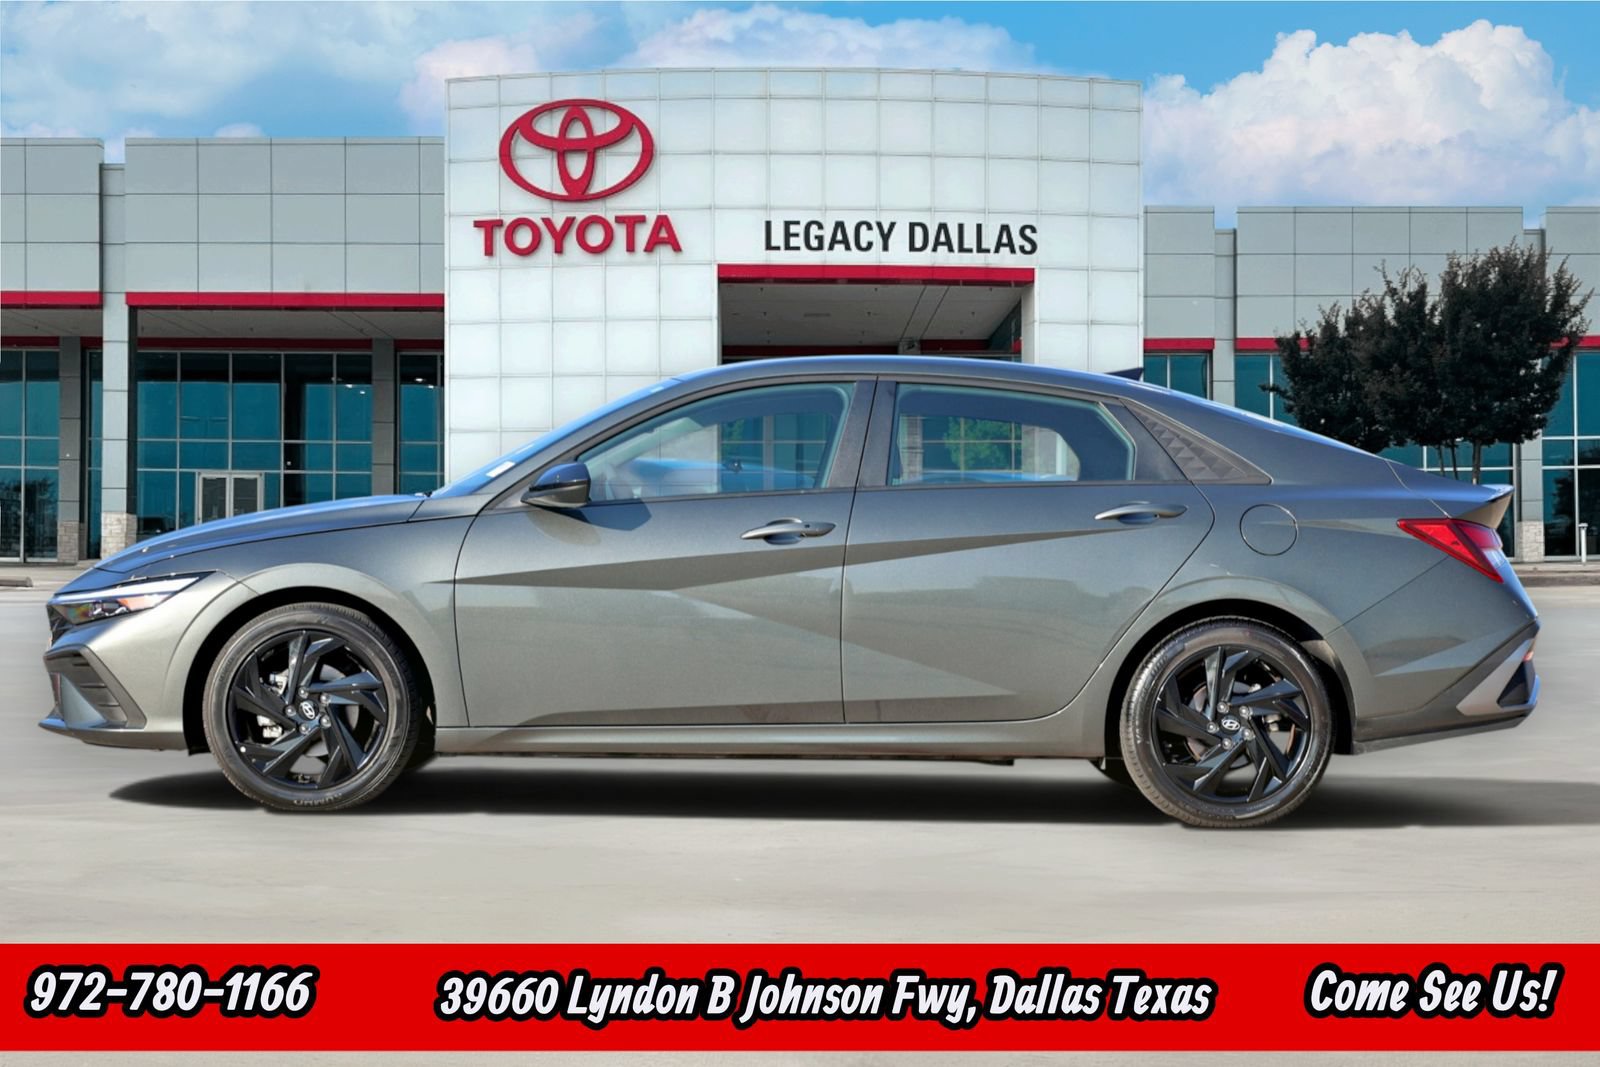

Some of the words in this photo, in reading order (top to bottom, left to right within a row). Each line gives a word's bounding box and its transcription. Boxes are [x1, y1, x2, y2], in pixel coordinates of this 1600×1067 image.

[473, 213, 682, 257] TOYOTA
[765, 220, 898, 252] LEGACY
[908, 221, 1038, 256] DALLAS
